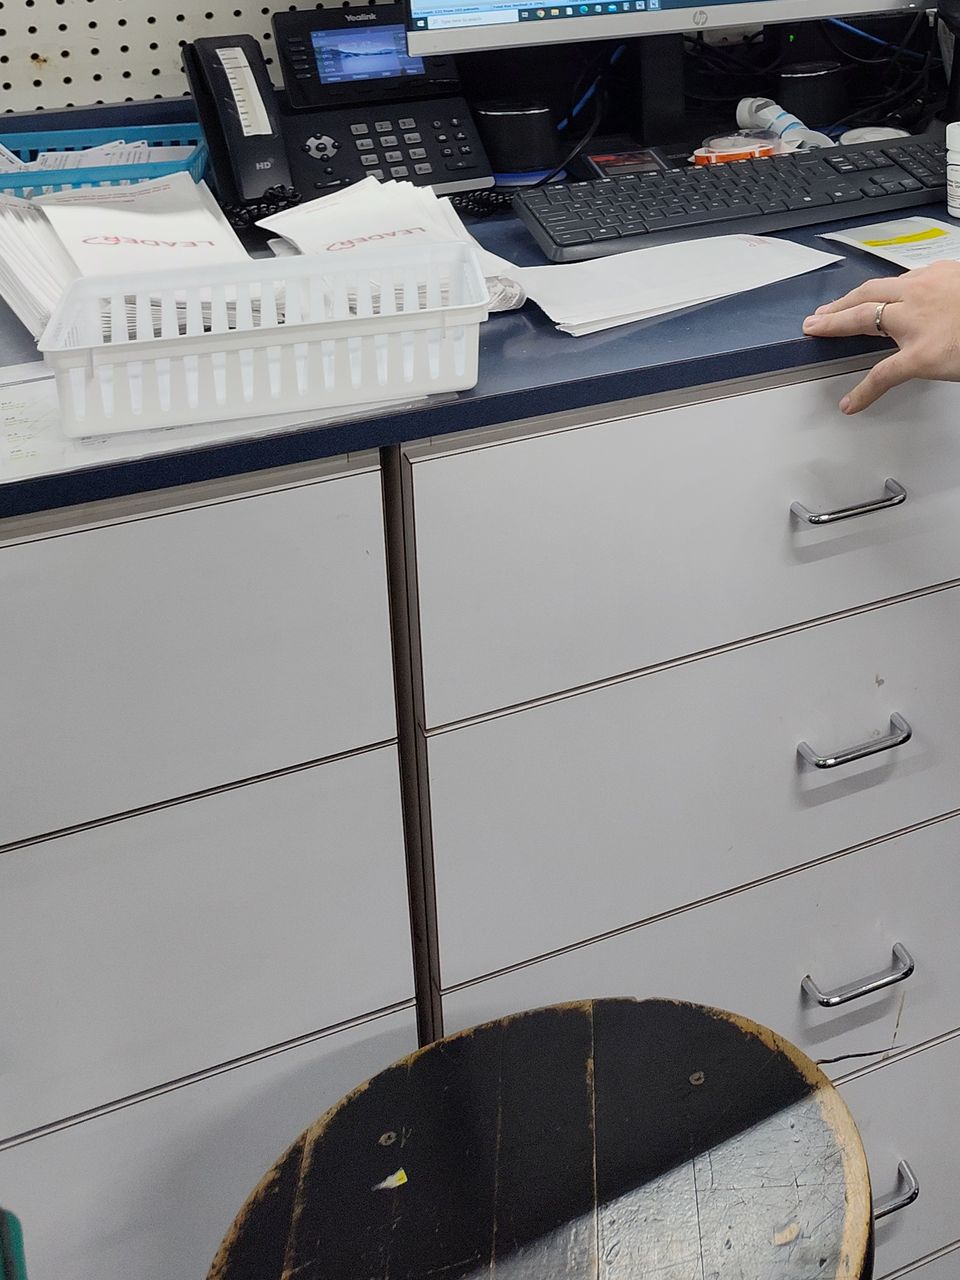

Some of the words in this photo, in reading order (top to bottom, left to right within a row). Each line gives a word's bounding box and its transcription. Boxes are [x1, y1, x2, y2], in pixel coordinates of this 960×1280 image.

[345, 13, 377, 21] Yealink
[255, 162, 271, 170] HD
[103, 236, 215, 247] LEADER
[339, 227, 427, 247] LEADER
